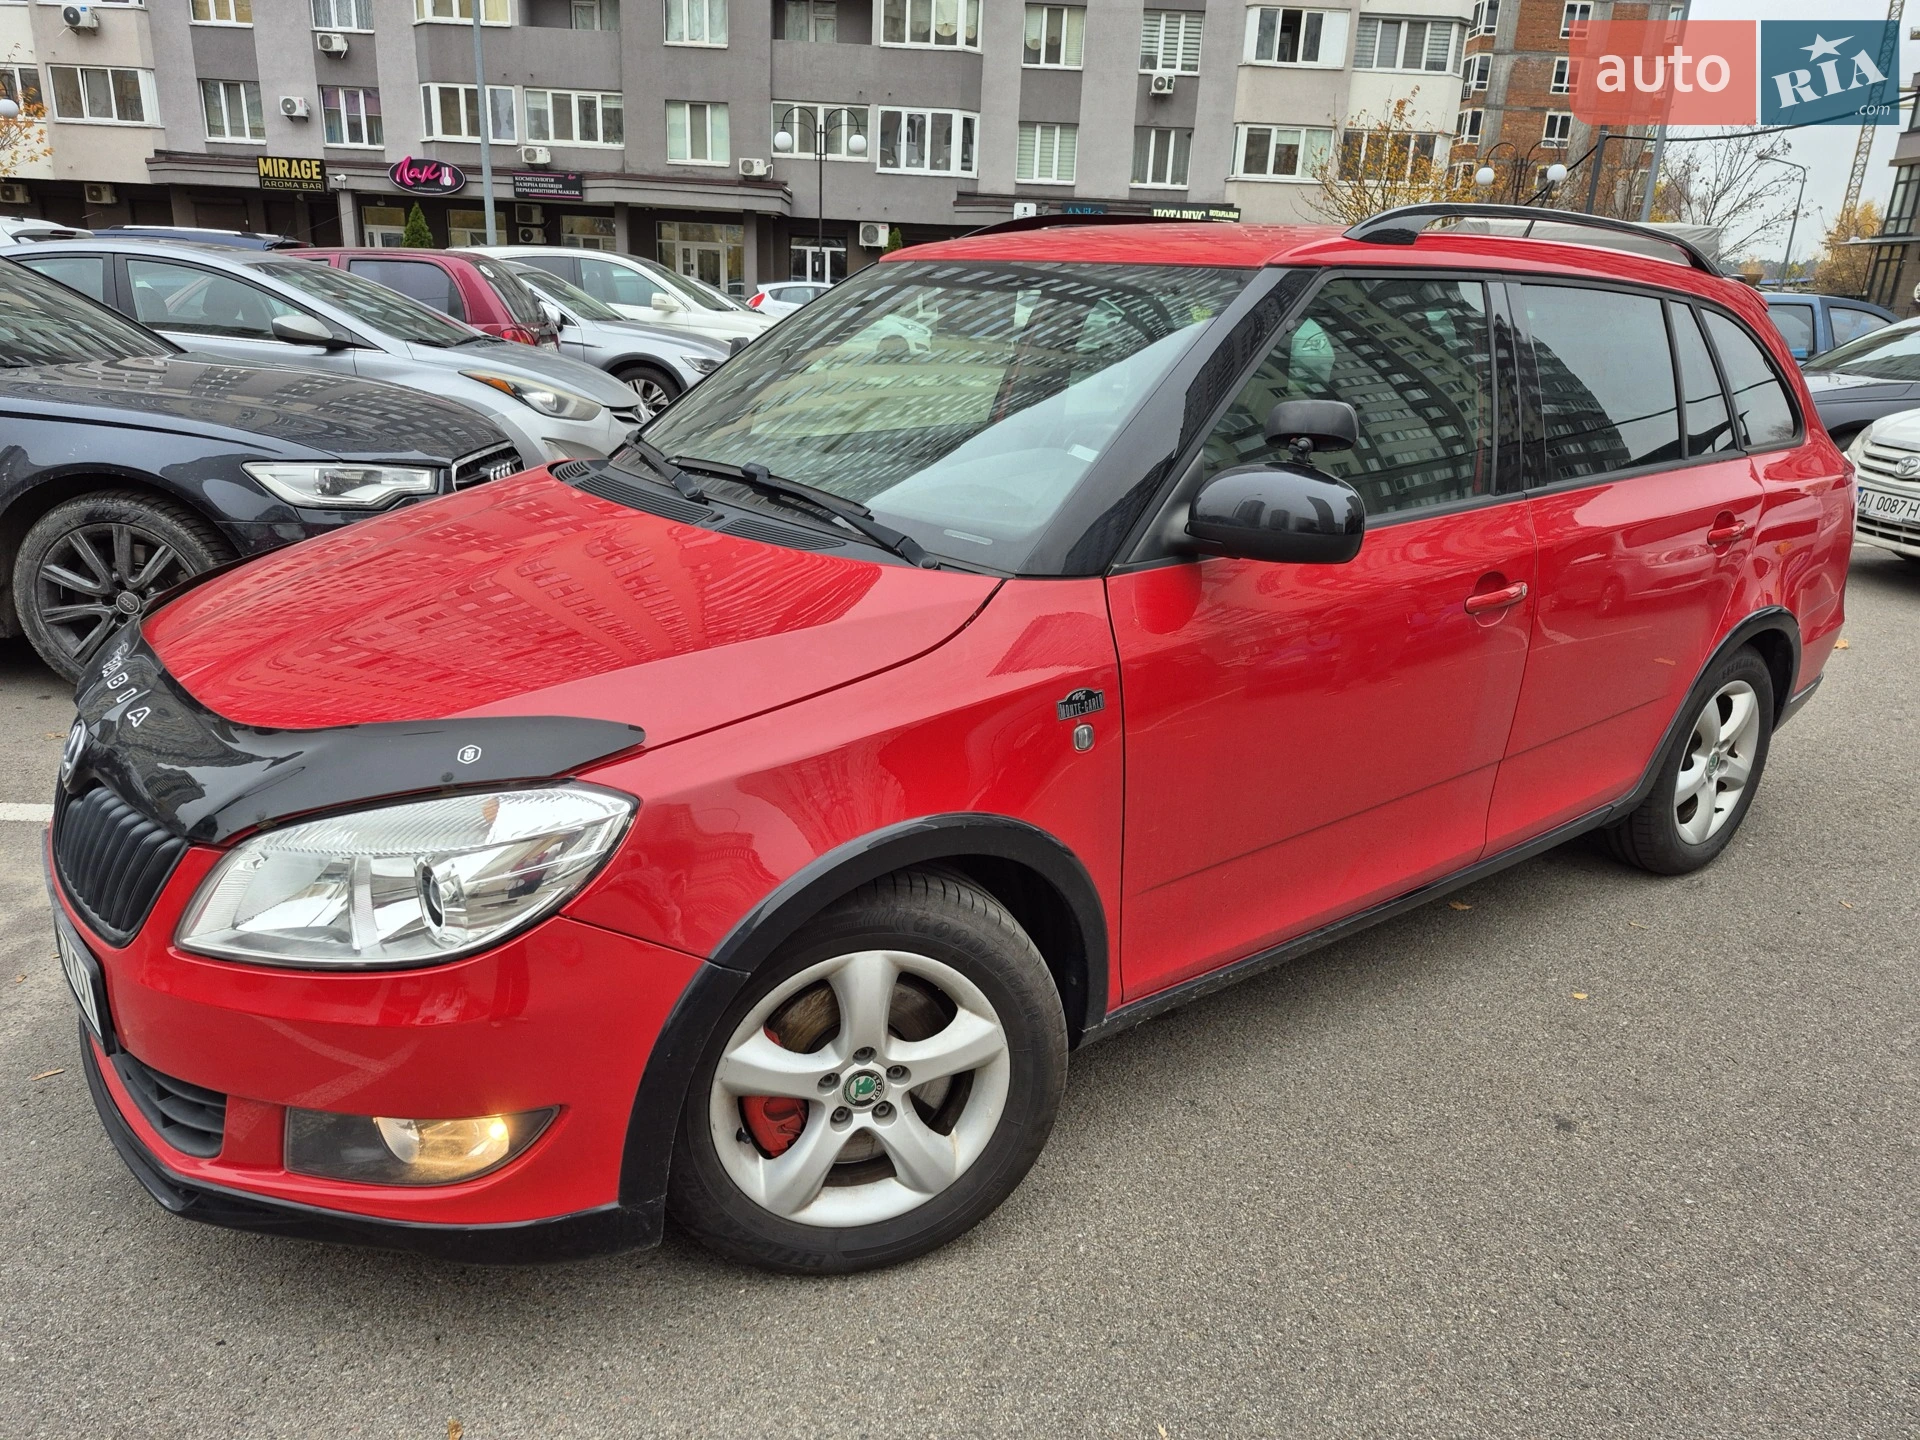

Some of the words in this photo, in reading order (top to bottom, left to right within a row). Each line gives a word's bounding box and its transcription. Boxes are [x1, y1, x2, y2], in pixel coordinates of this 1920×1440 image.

[258, 157, 322, 180] MIRAGE
[264, 180, 300, 189] AROMA
[302, 182, 322, 190] BAR
[1876, 496, 1908, 515] 0087
